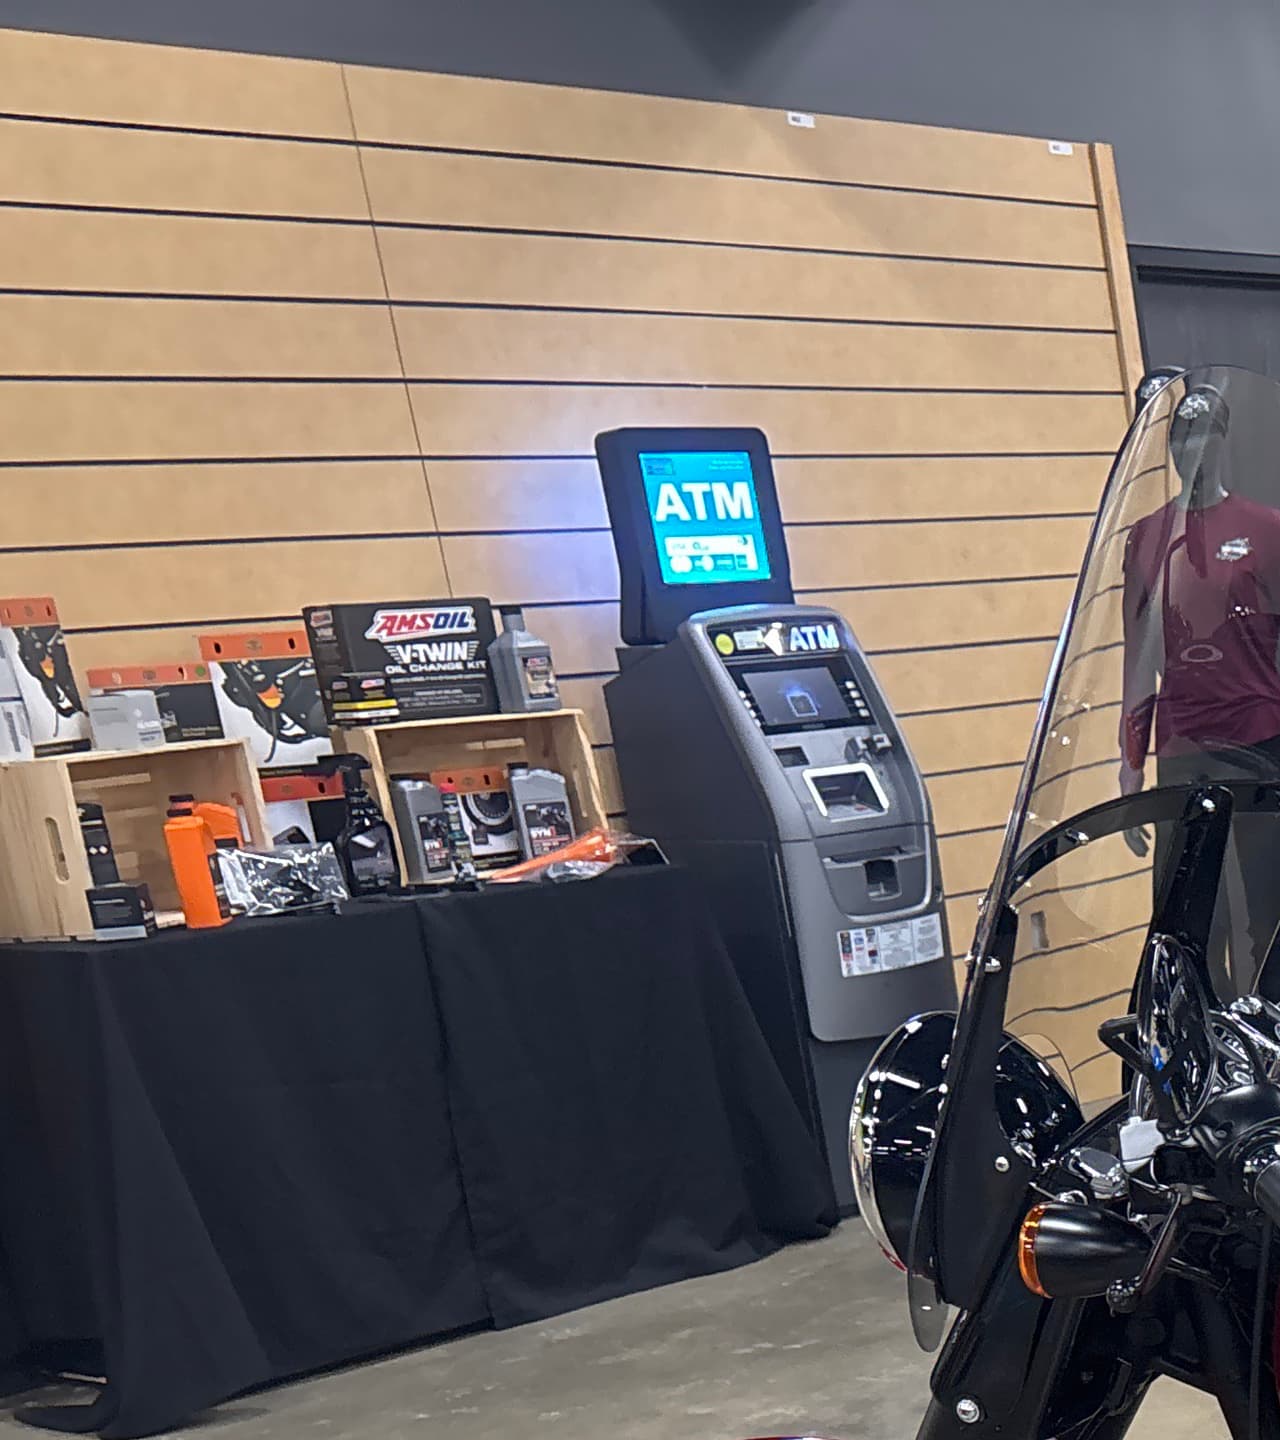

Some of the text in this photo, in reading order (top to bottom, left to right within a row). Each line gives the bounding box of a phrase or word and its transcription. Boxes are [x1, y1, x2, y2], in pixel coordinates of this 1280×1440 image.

[655, 481, 754, 522] ATM
[375, 611, 469, 637] AMSOIL
[789, 624, 841, 652] ATM
[385, 660, 487, 675] OIL CHANGE KIT
